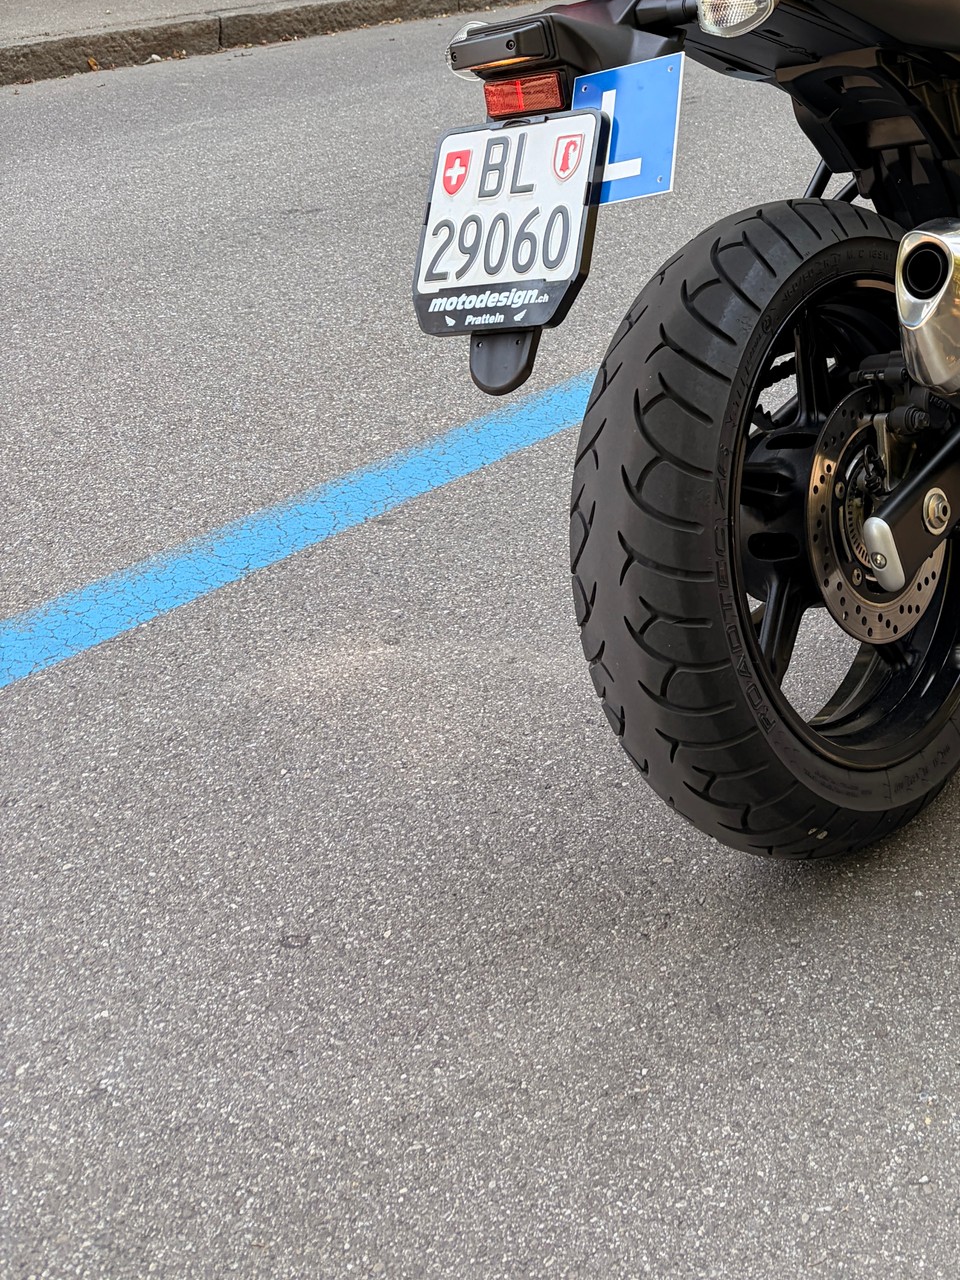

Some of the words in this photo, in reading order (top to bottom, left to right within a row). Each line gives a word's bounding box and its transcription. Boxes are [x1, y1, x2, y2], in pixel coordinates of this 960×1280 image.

[478, 132, 536, 199] BL
[602, 88, 642, 183] L
[424, 204, 571, 283] 29060
[428, 288, 550, 312] motodesign.ch
[464, 312, 505, 326] Pratteln
[714, 525, 776, 735] ROADTEC
